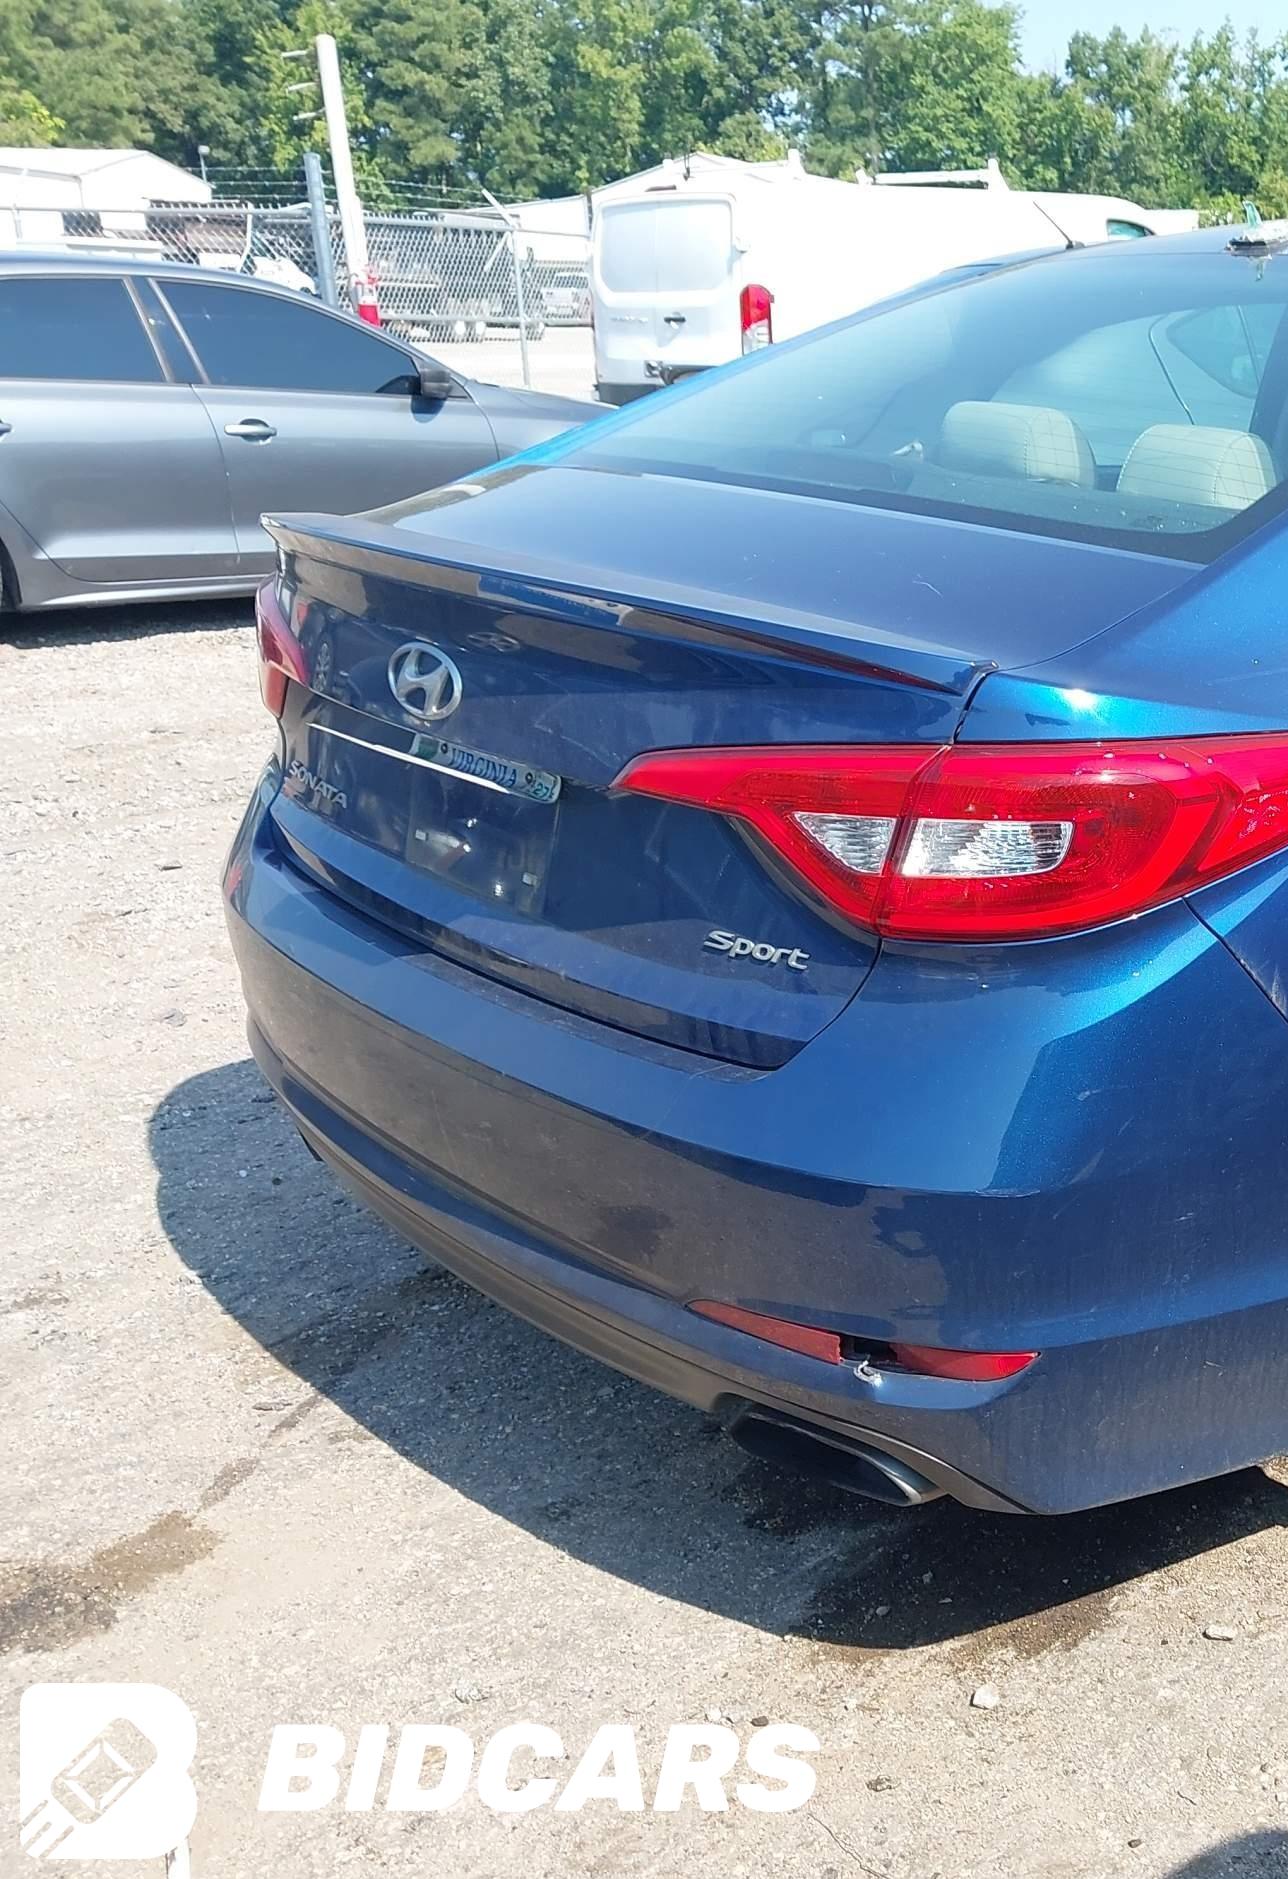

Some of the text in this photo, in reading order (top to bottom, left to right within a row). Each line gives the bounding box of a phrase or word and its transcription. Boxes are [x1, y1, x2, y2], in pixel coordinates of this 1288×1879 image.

[288, 759, 347, 809] SONATA
[448, 747, 517, 788] VIRGINIA
[703, 930, 810, 970] Sport
